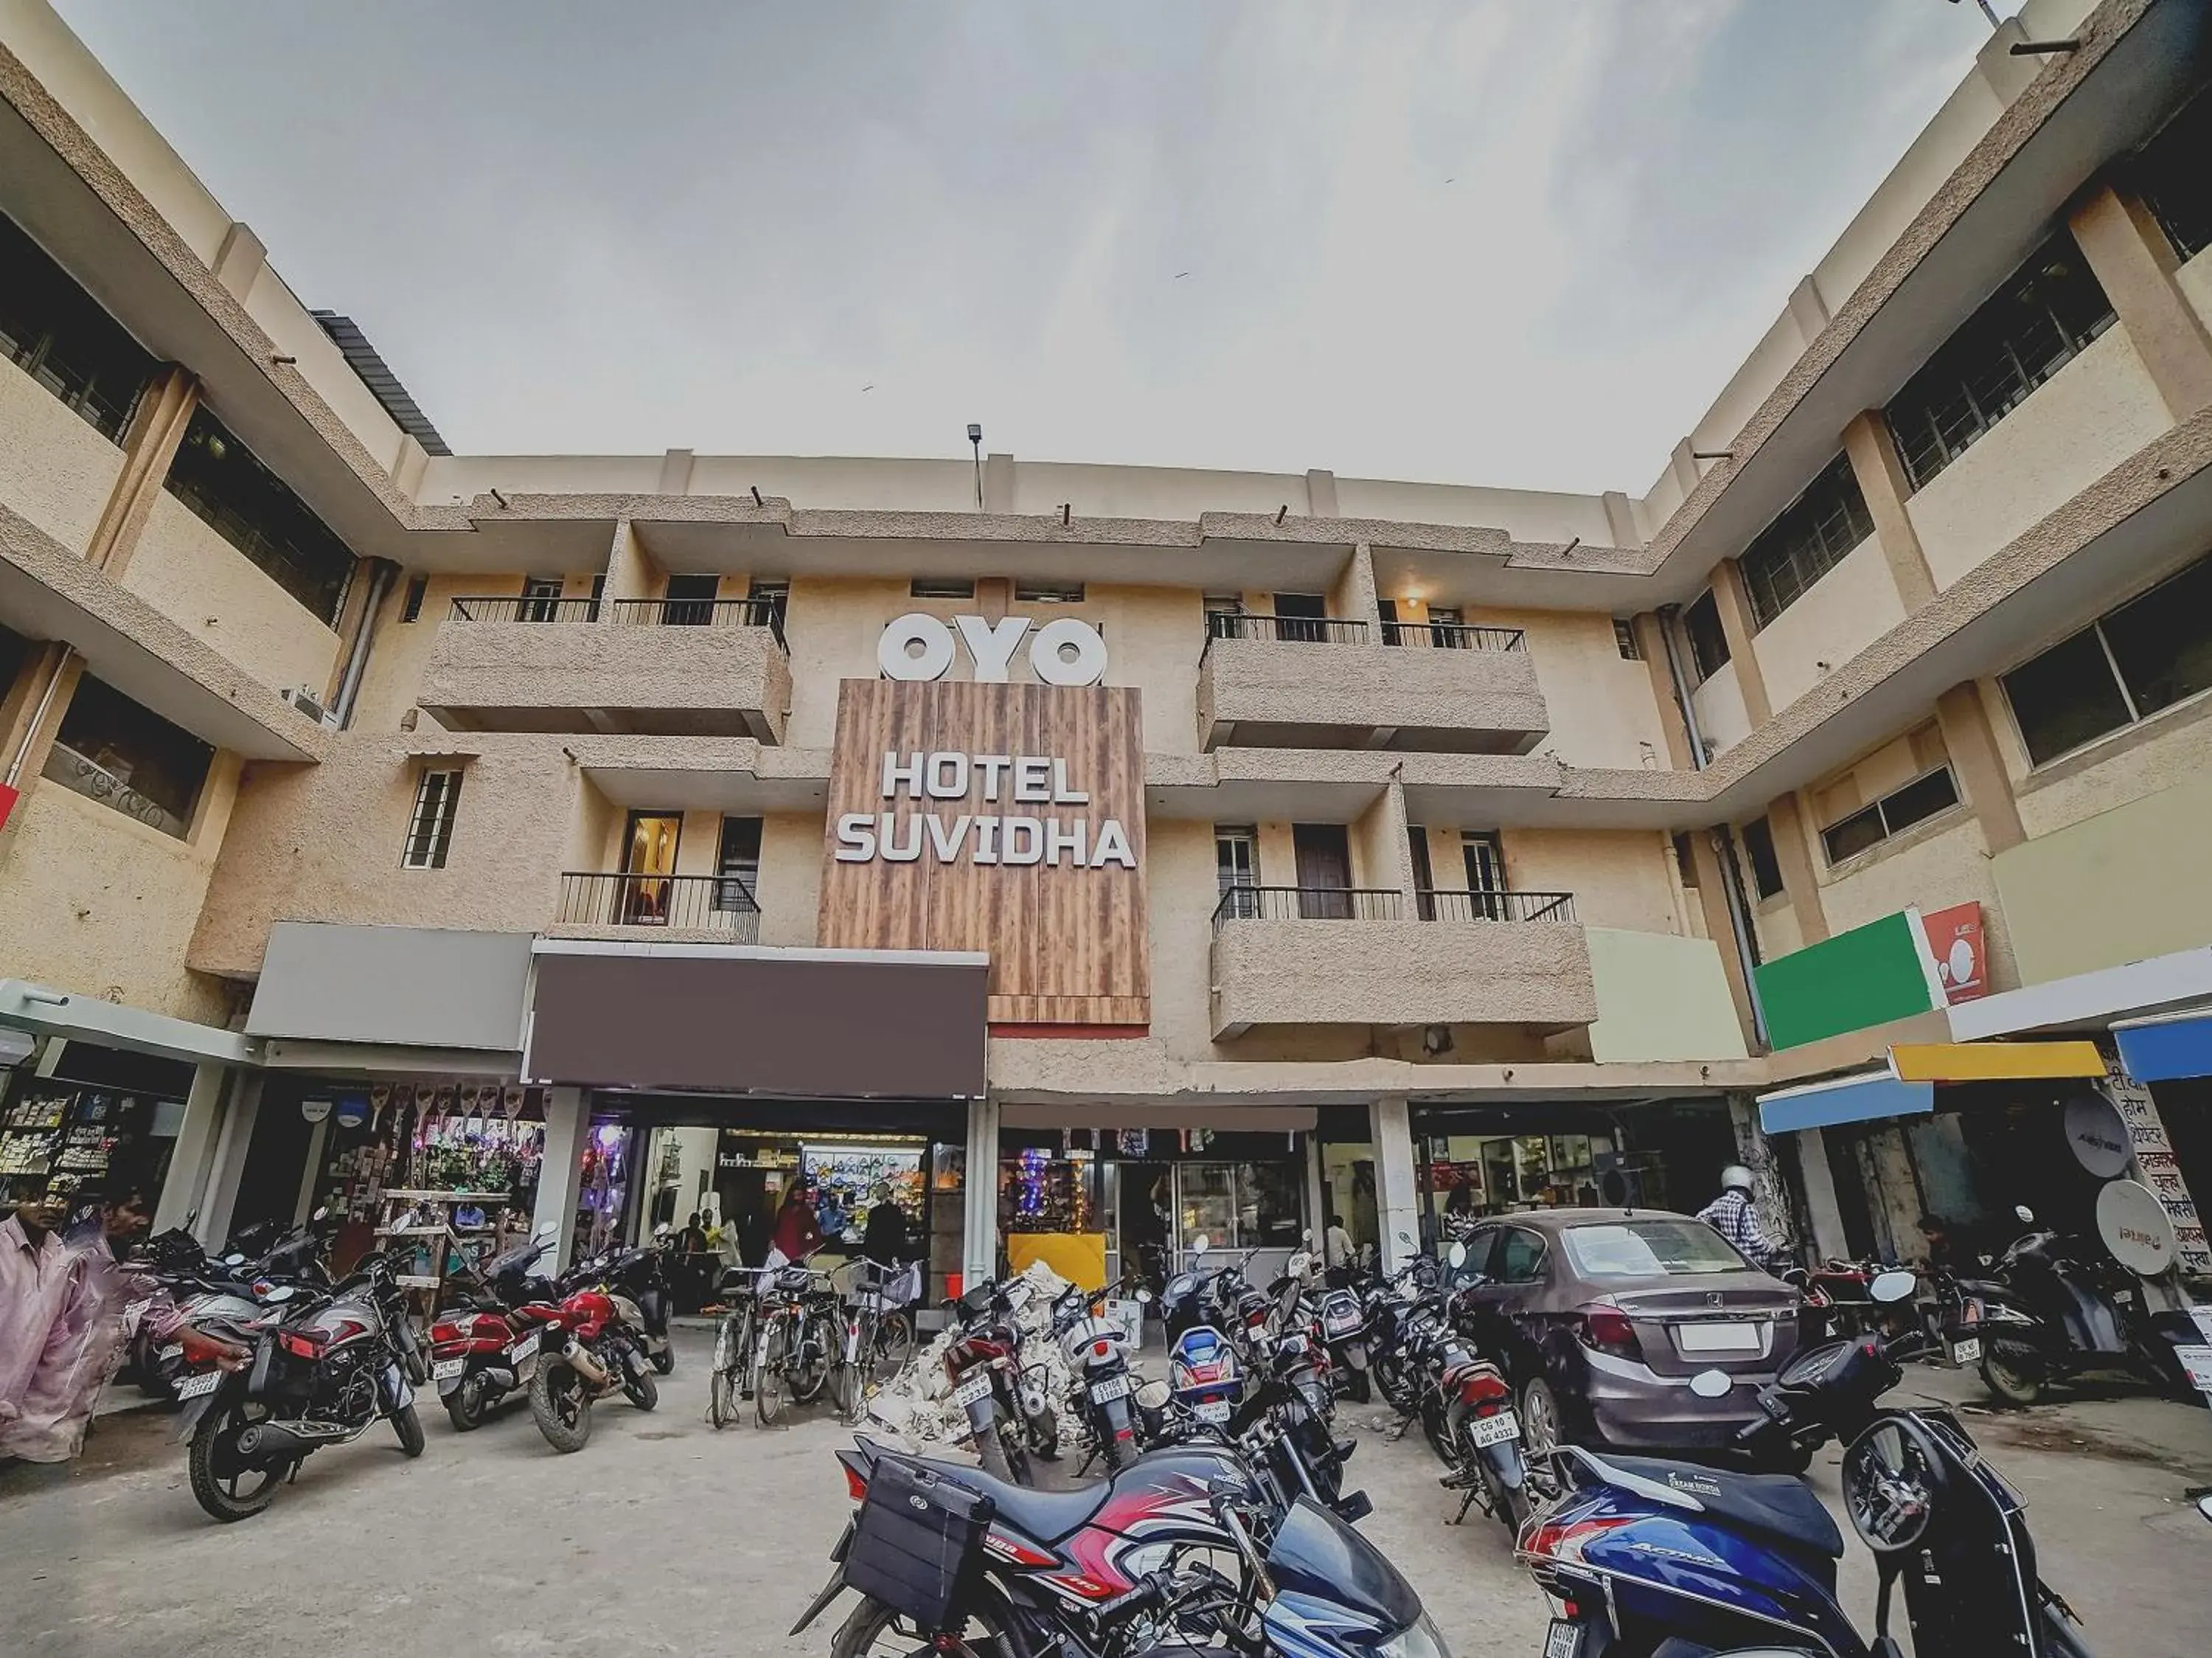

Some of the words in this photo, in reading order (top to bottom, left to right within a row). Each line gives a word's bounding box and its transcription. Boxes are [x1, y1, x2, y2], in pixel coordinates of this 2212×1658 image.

[877, 613, 1107, 686] OYO
[883, 752, 1089, 804] HOTEL
[835, 813, 1138, 869] SUVIDHA
[2120, 1095, 2147, 1122] होम
[1480, 1433, 1492, 1445] AG
[1494, 1427, 1514, 1440] 4332
[1481, 1421, 1493, 1432] CG
[1495, 1417, 1505, 1427] 10
